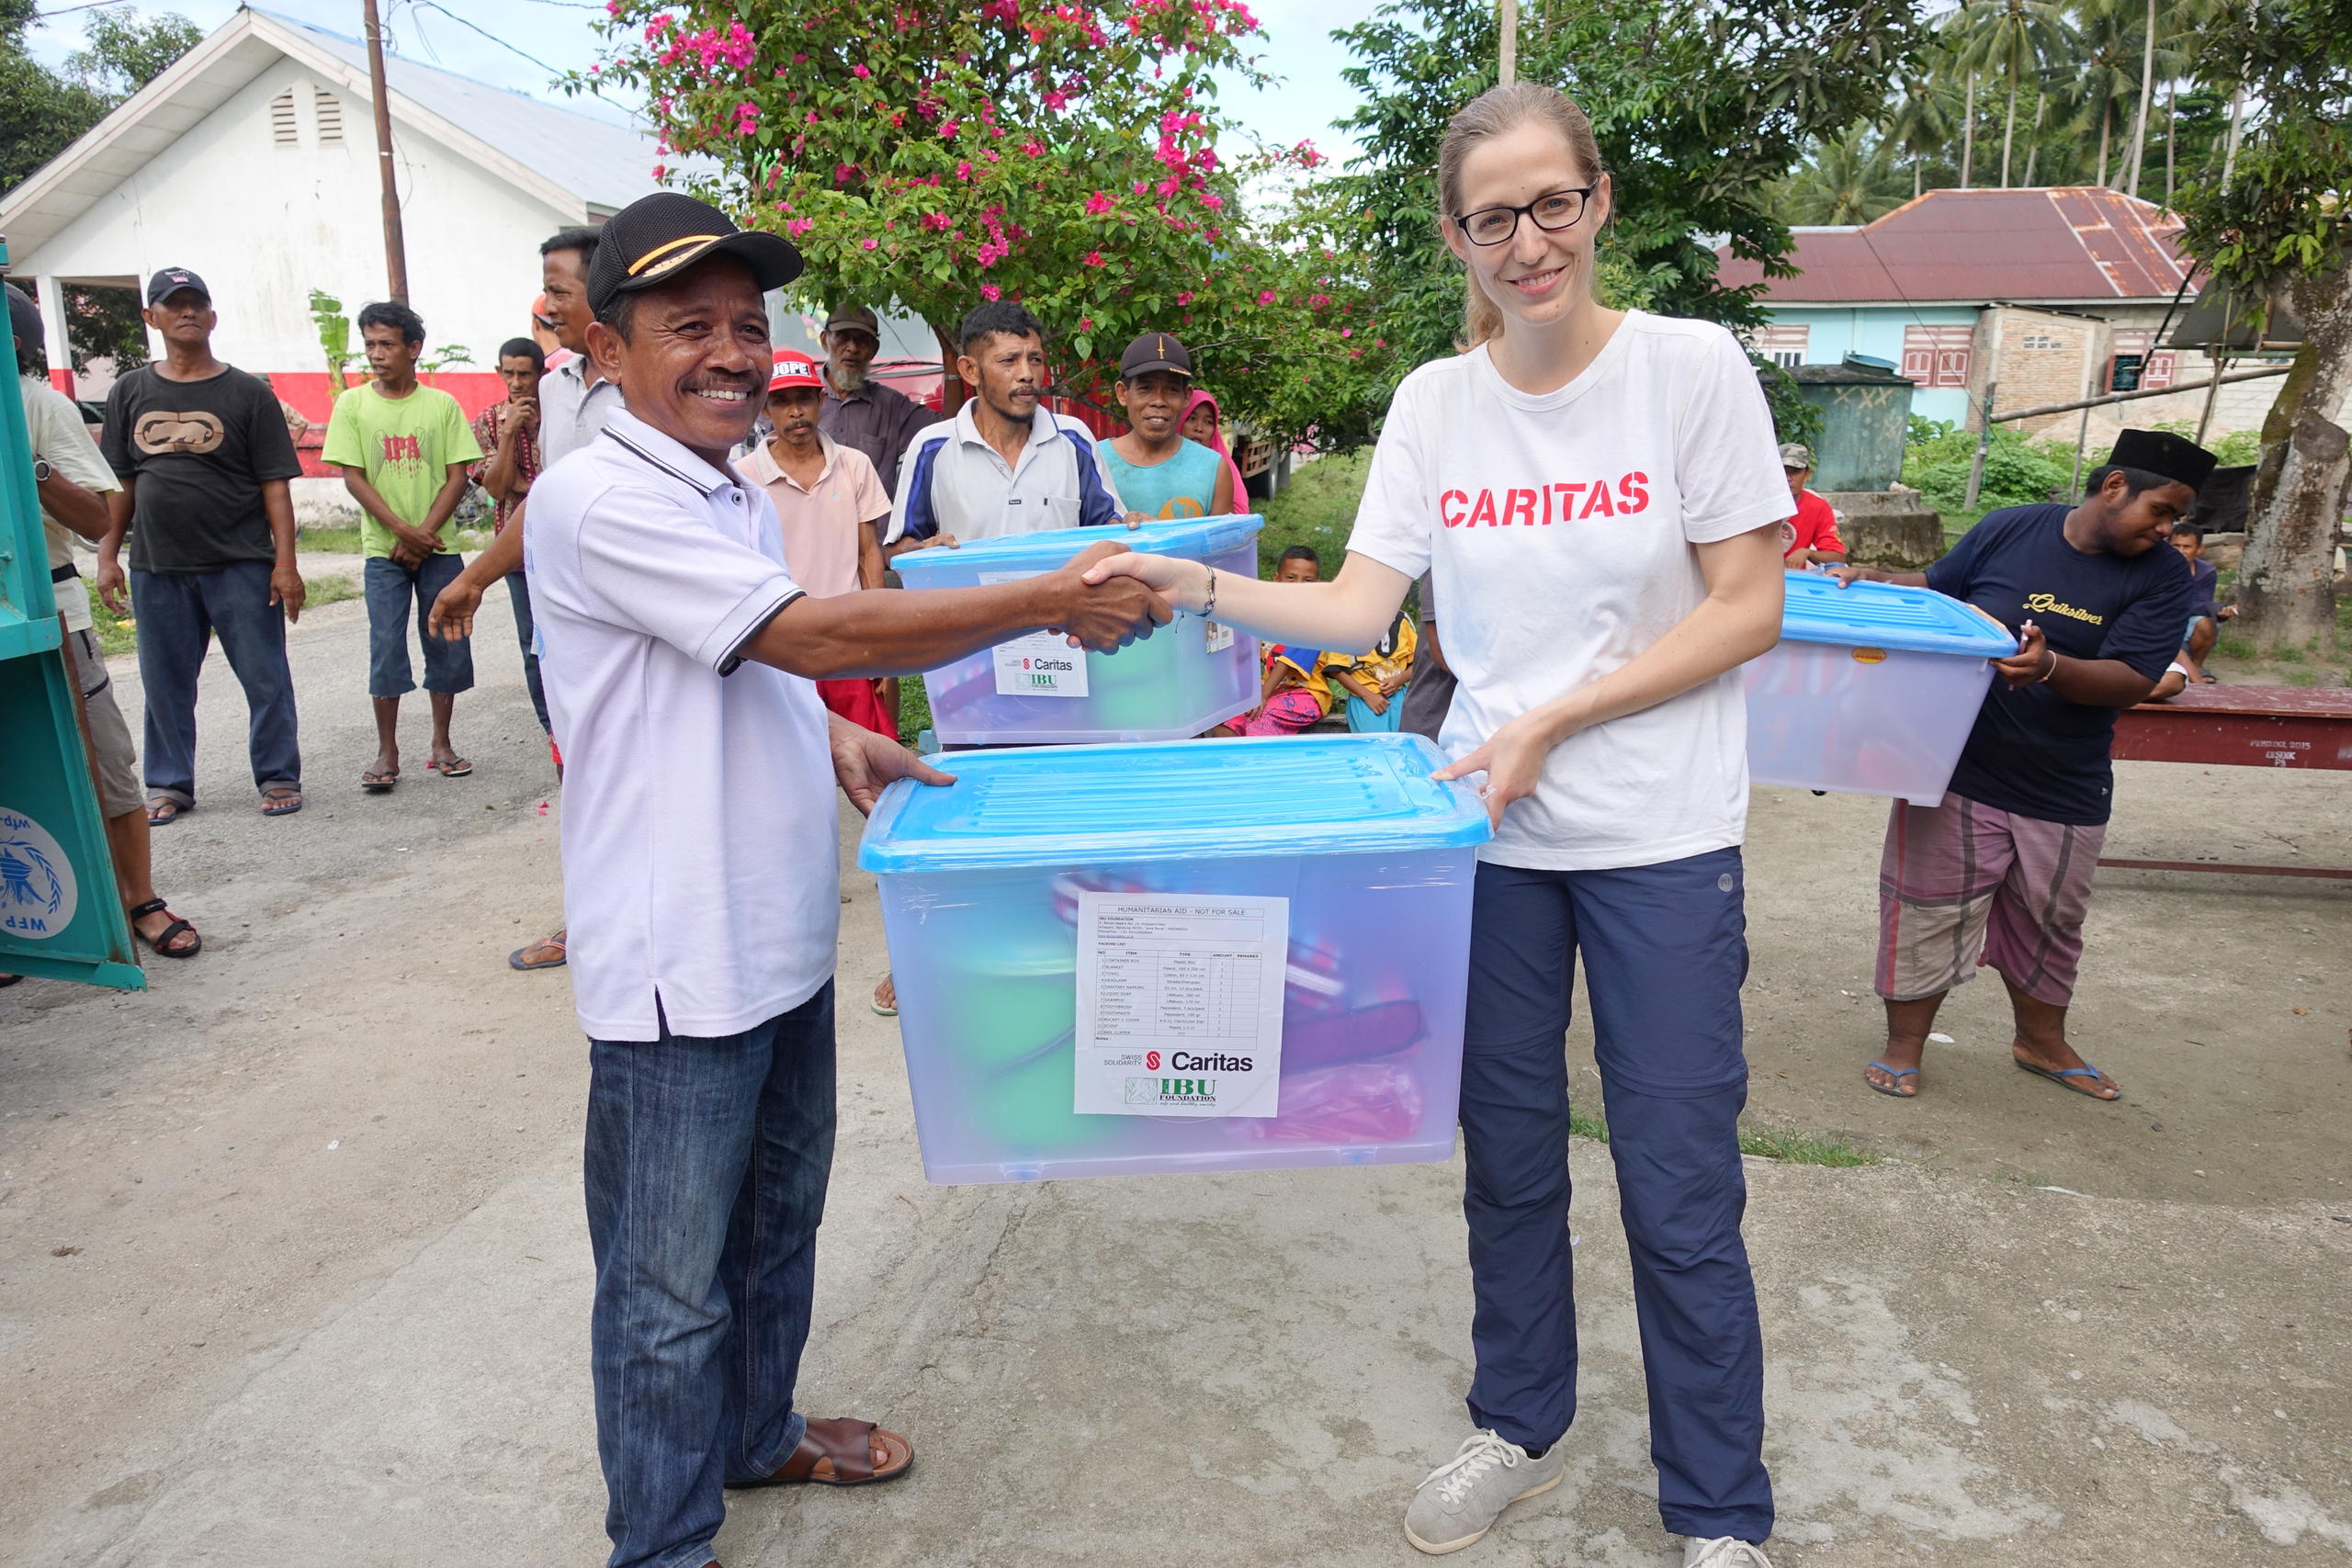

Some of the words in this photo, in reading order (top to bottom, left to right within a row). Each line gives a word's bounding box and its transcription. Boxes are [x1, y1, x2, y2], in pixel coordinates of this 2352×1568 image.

[1440, 471, 1649, 528] CARITAS
[2022, 593, 2103, 625] Quiksilver
[1035, 659, 1073, 671] Caritas
[1031, 674, 1057, 684] IBU
[6, 916, 48, 931] WFP
[1171, 1051, 1253, 1072] Caritas
[1159, 1078, 1217, 1096] IBU
